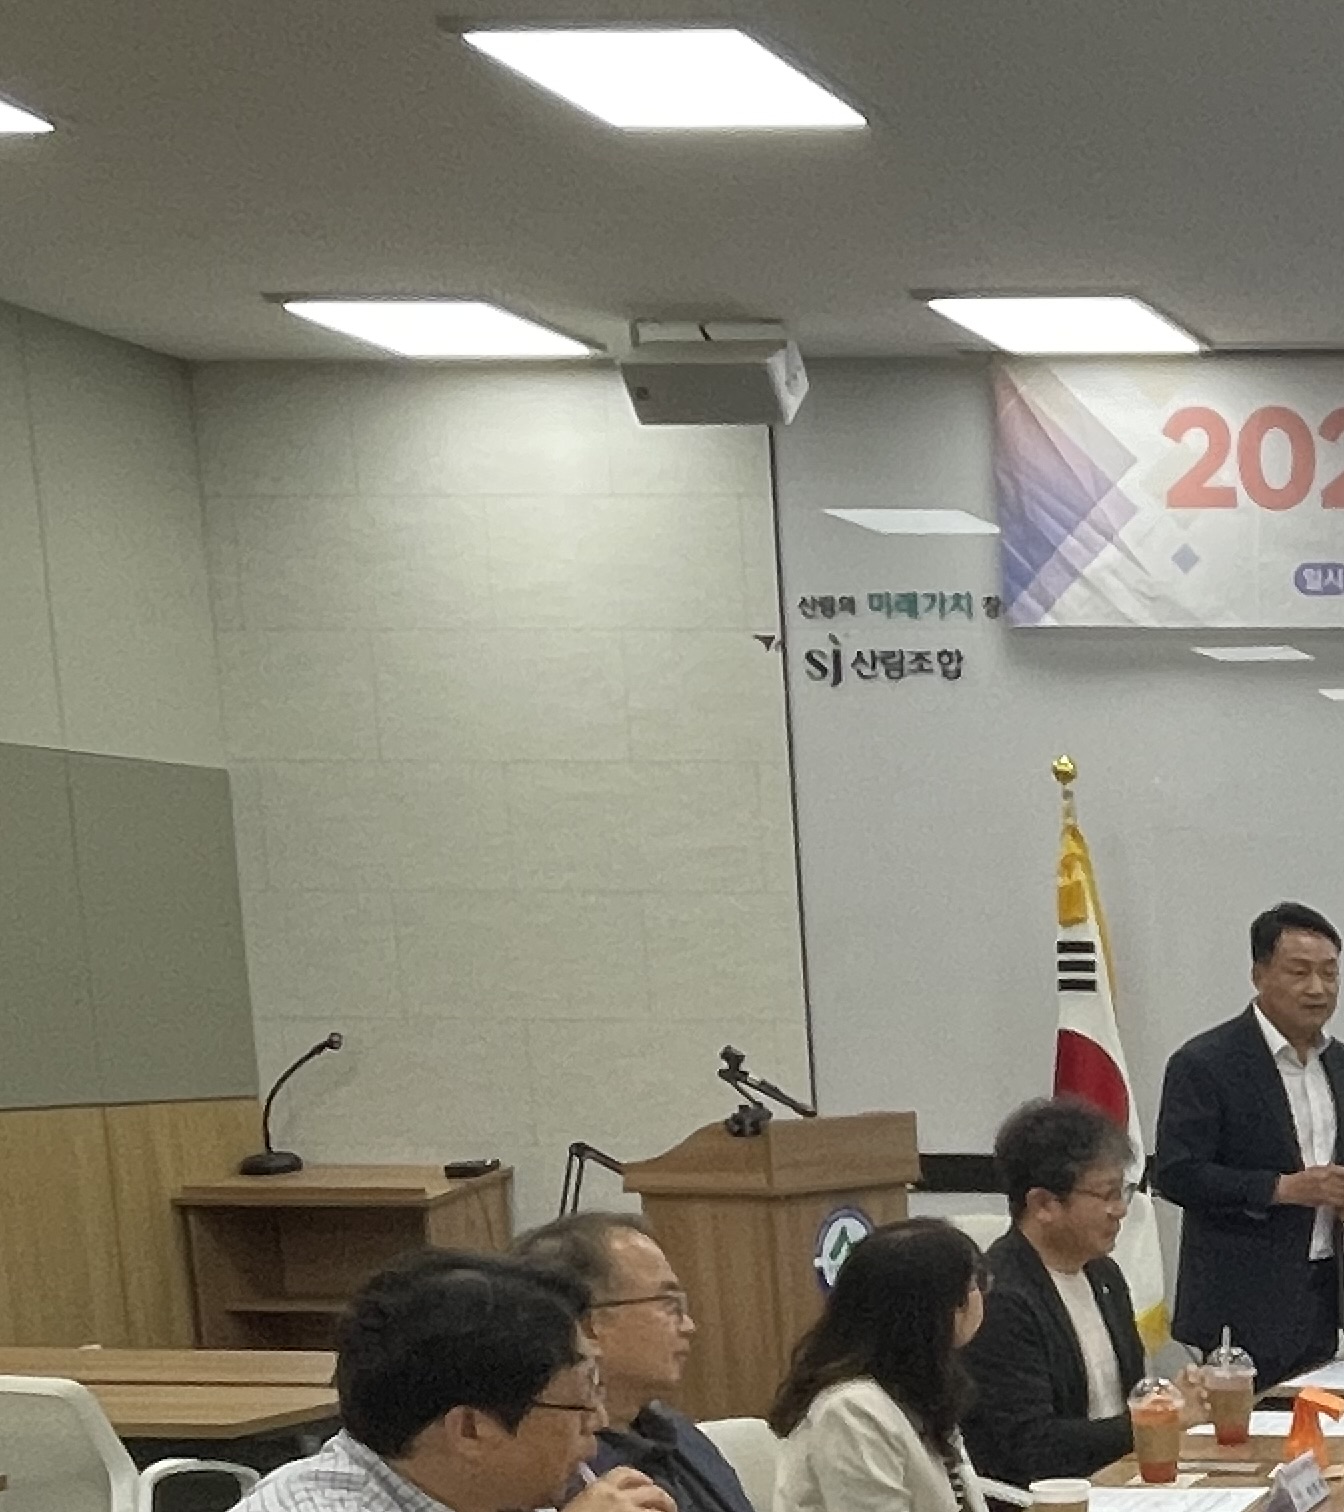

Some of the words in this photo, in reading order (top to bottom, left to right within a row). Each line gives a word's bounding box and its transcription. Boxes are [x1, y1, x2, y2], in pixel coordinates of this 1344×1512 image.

[1302, 568, 1344, 591] 일시
[867, 590, 973, 620] 미래가치
[851, 648, 965, 682] 산림조합
